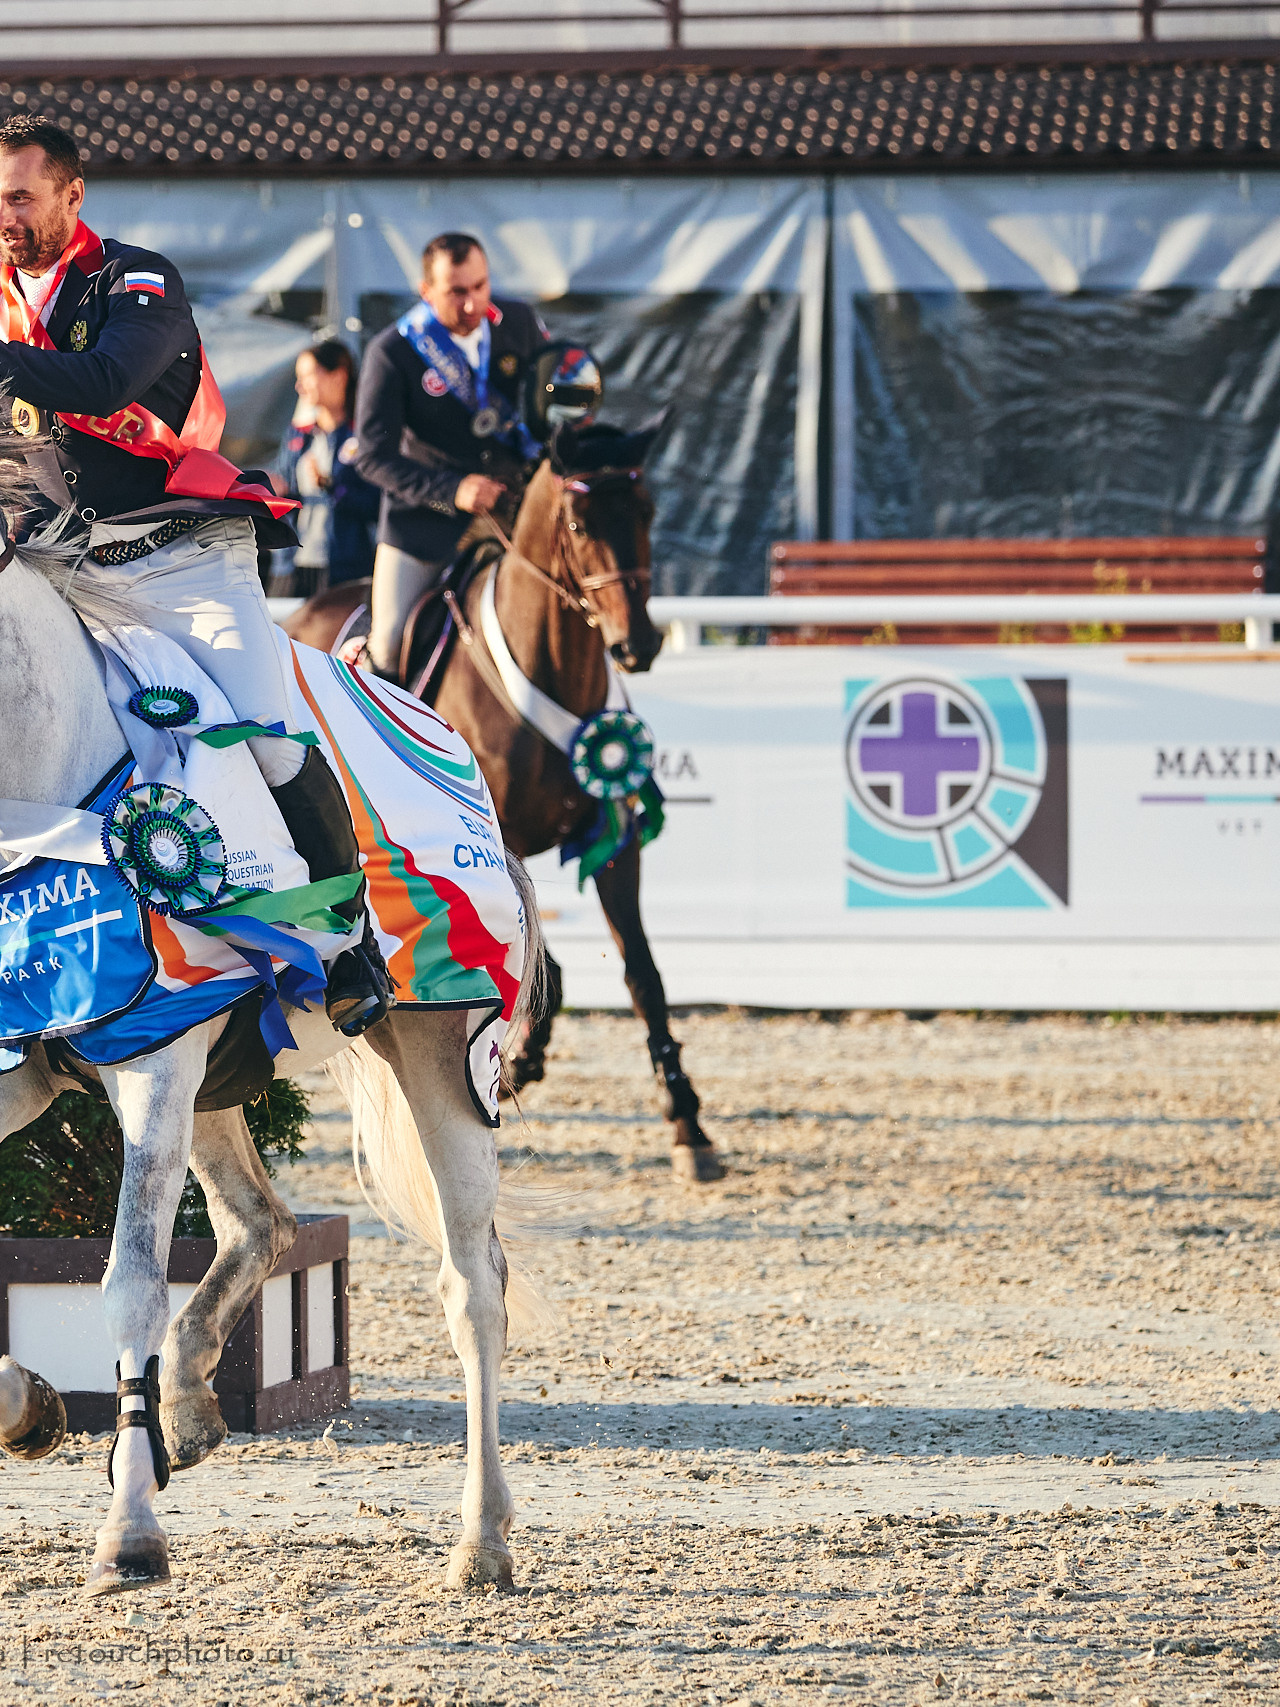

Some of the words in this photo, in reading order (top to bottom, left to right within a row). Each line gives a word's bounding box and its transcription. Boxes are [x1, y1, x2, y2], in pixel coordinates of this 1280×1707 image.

[226, 849, 257, 864] USSIAN
[227, 863, 273, 881] QUESTRIAN
[1, 956, 63, 985] PARK
